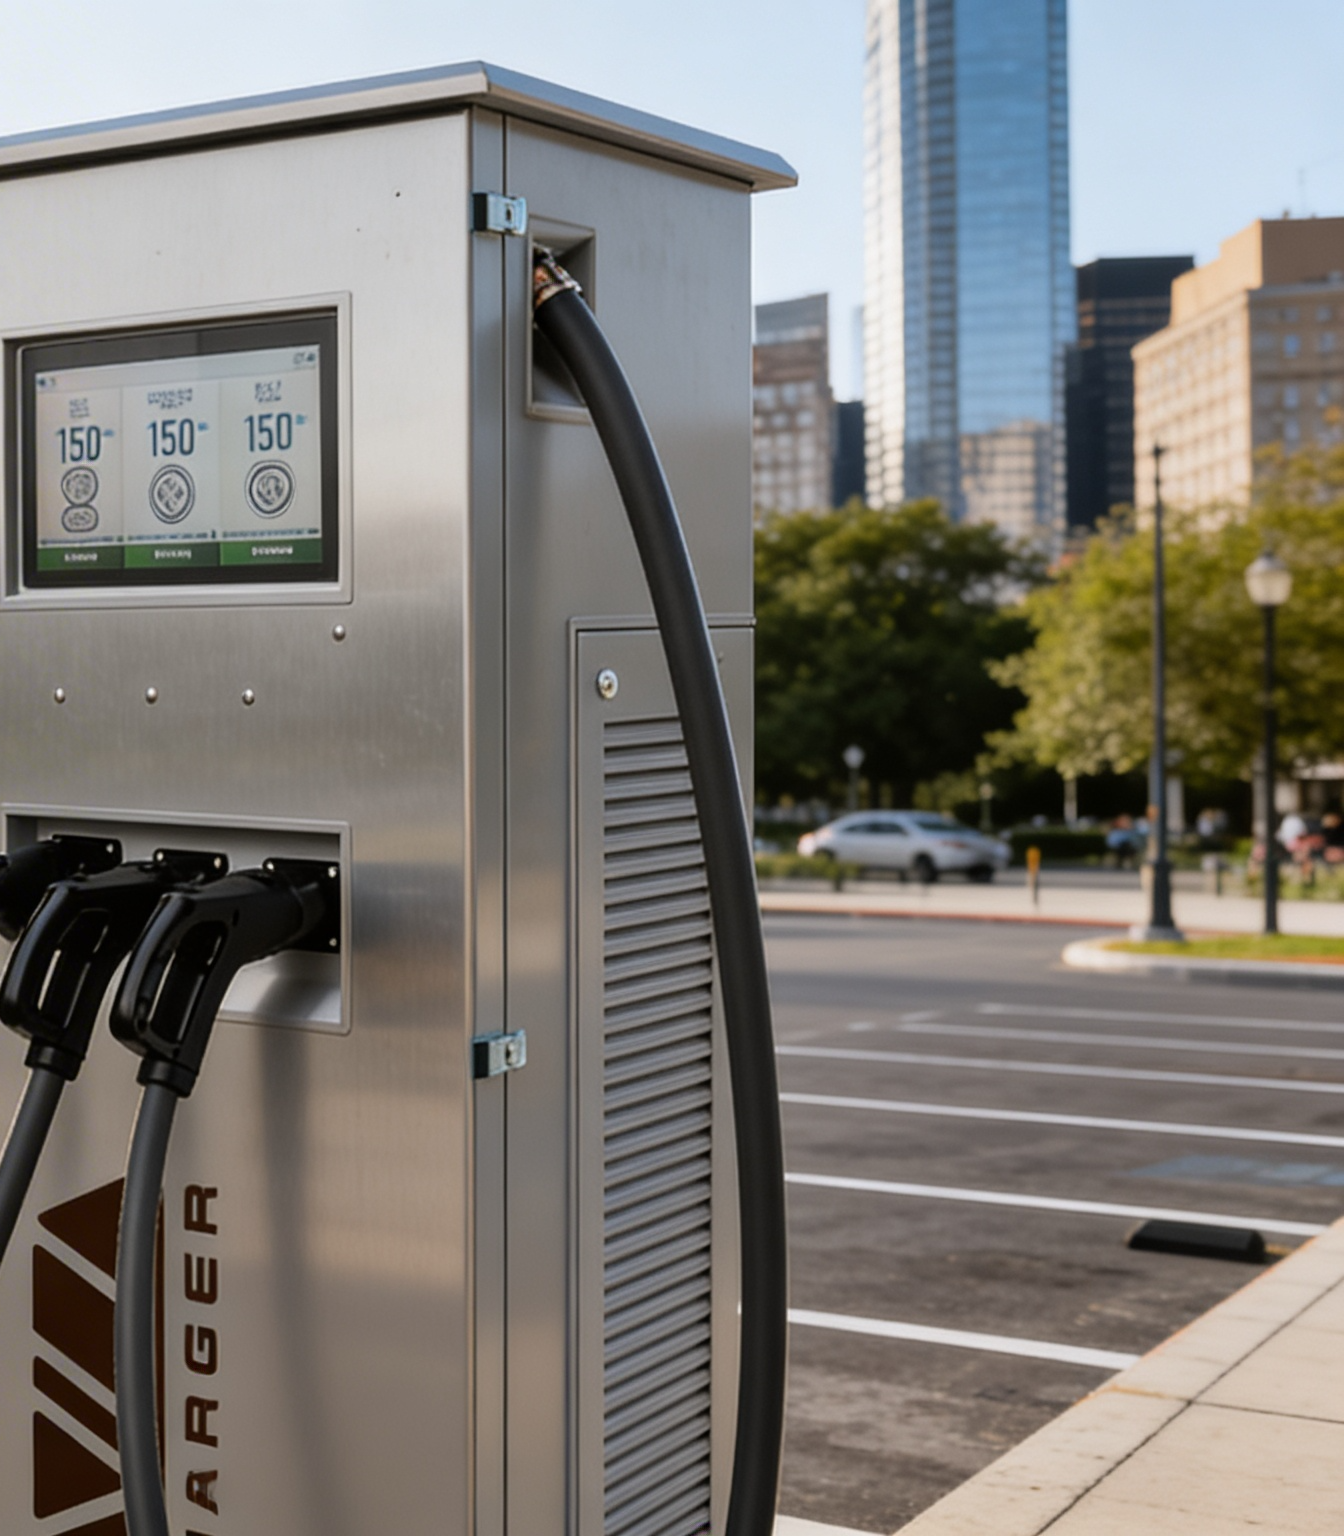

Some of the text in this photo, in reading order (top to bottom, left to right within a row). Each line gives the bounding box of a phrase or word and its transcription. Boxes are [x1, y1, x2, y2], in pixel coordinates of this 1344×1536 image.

[56, 425, 101, 464] 150
[147, 418, 194, 457] 150
[244, 412, 292, 453] 150
[184, 1183, 219, 1536] ARGER
